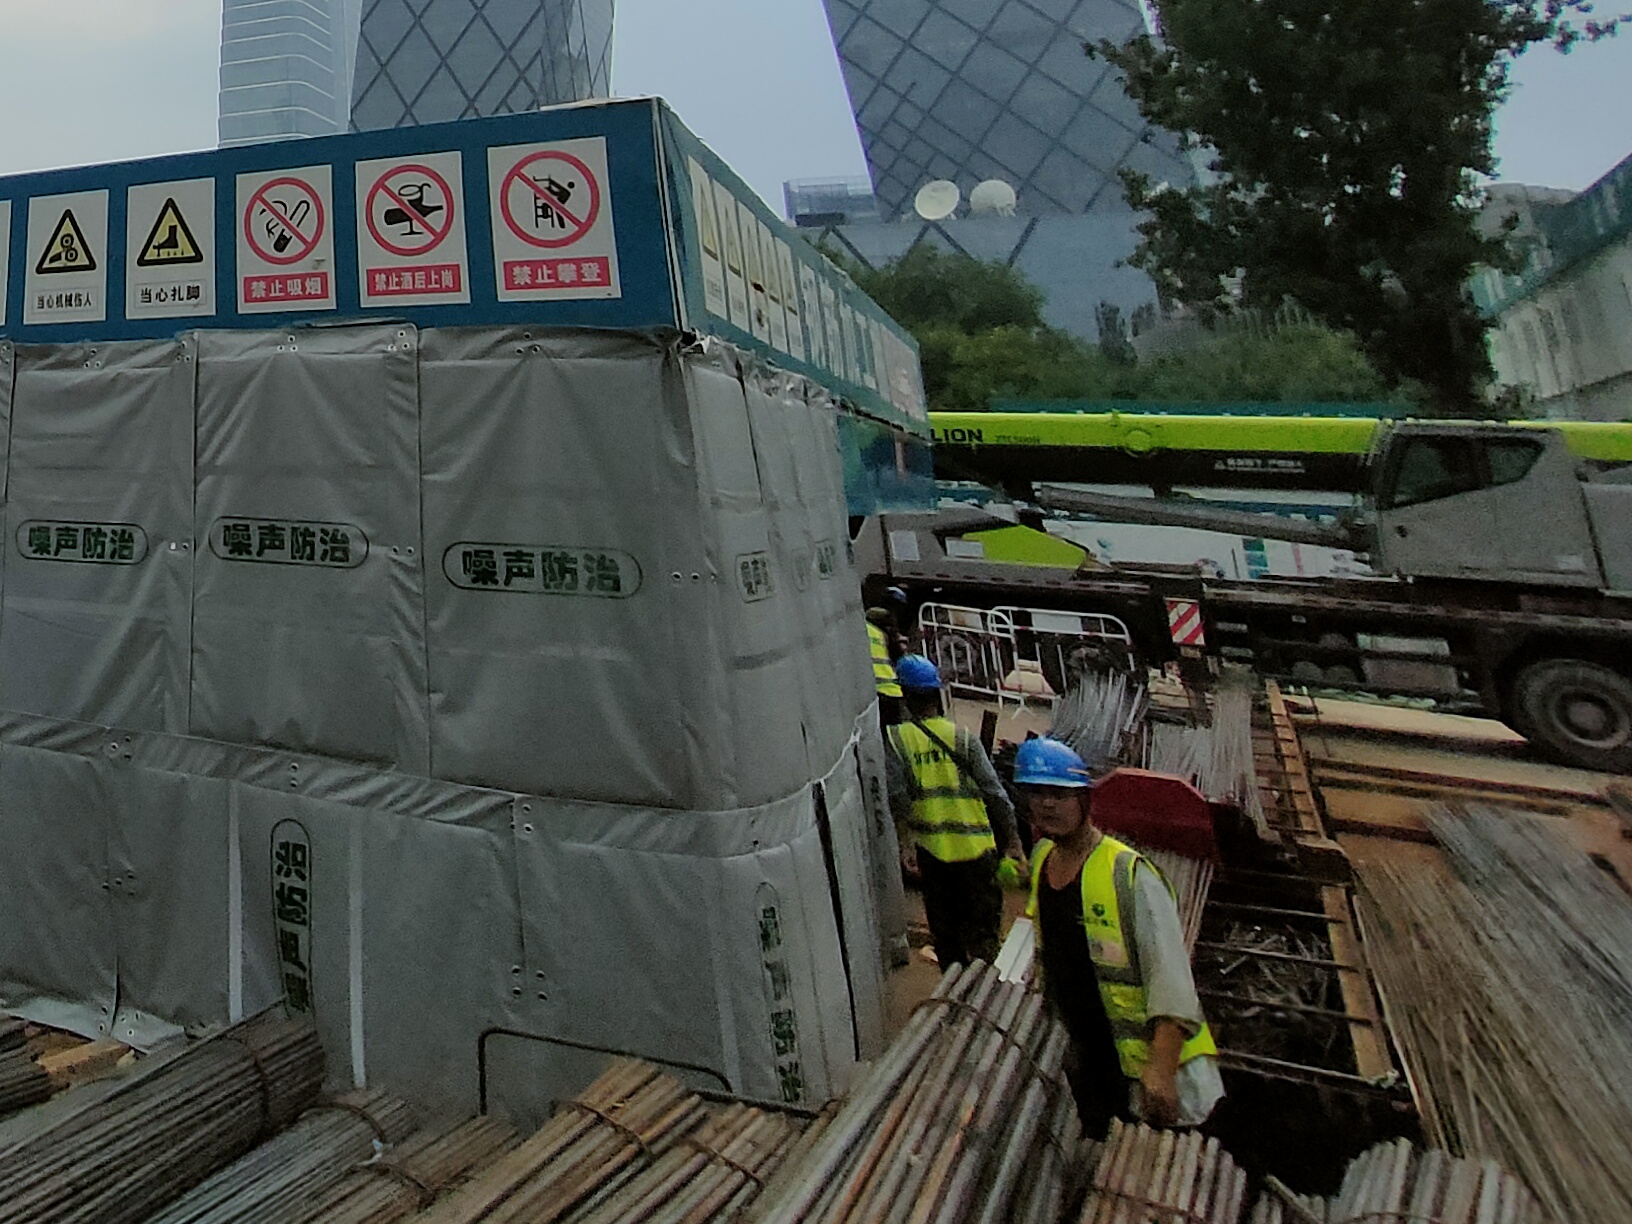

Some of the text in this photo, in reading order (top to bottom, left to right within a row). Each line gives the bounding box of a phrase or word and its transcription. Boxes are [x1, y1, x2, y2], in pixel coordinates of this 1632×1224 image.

[374, 268, 454, 291] 禁止酒后上岗
[511, 262, 602, 286] 禁止攀登
[140, 284, 201, 303] 当心扎脚
[250, 277, 322, 299] 禁止吸烟
[36, 292, 92, 310] 当心机械伤人
[27, 526, 135, 560] 噪声防治
[222, 522, 351, 564] 噪声防治
[461, 548, 623, 594] 噪声防治
